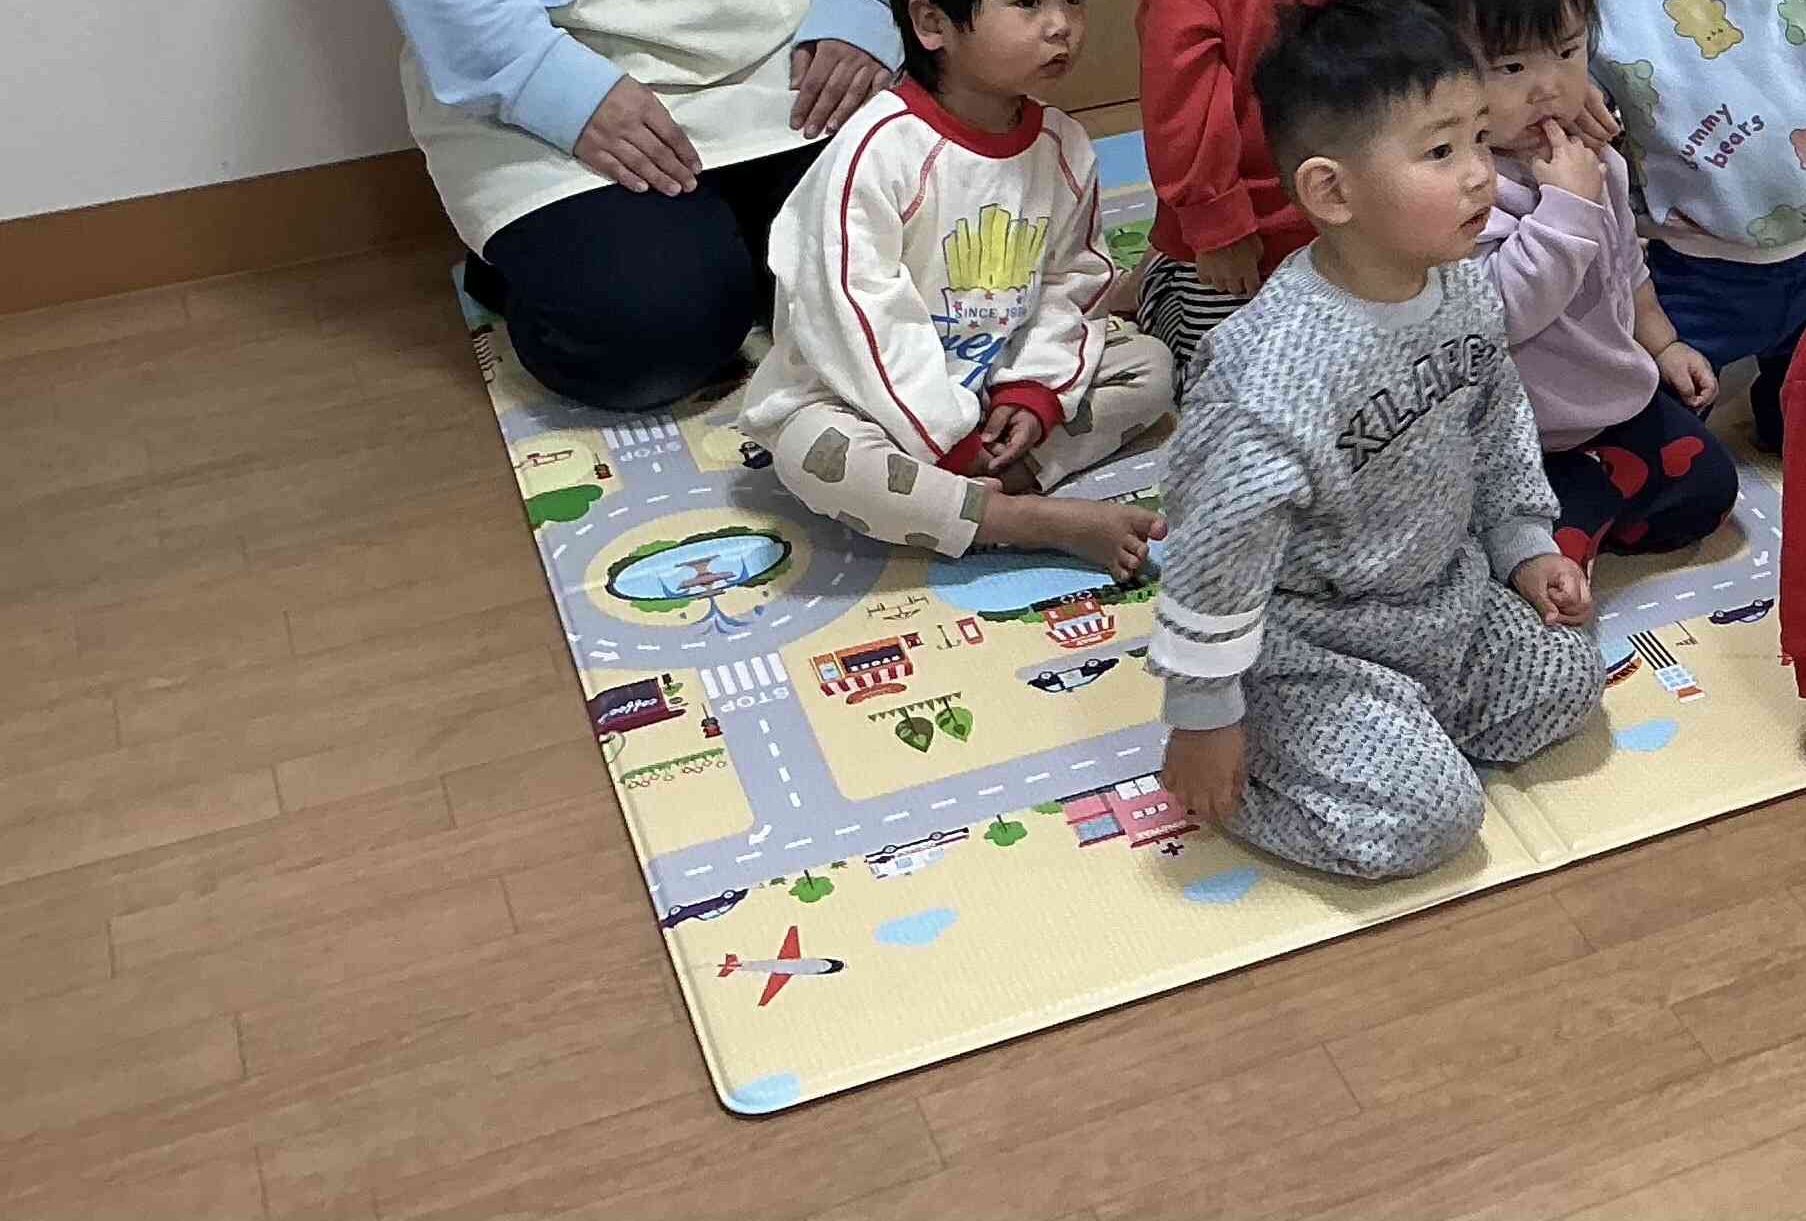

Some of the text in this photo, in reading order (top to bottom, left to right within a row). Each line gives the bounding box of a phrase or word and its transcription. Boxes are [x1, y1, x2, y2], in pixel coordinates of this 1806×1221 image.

[1704, 114, 1765, 168] bears
[955, 307, 998, 319] SINCE
[603, 698, 658, 718] coffee
[720, 686, 790, 712] STOP
